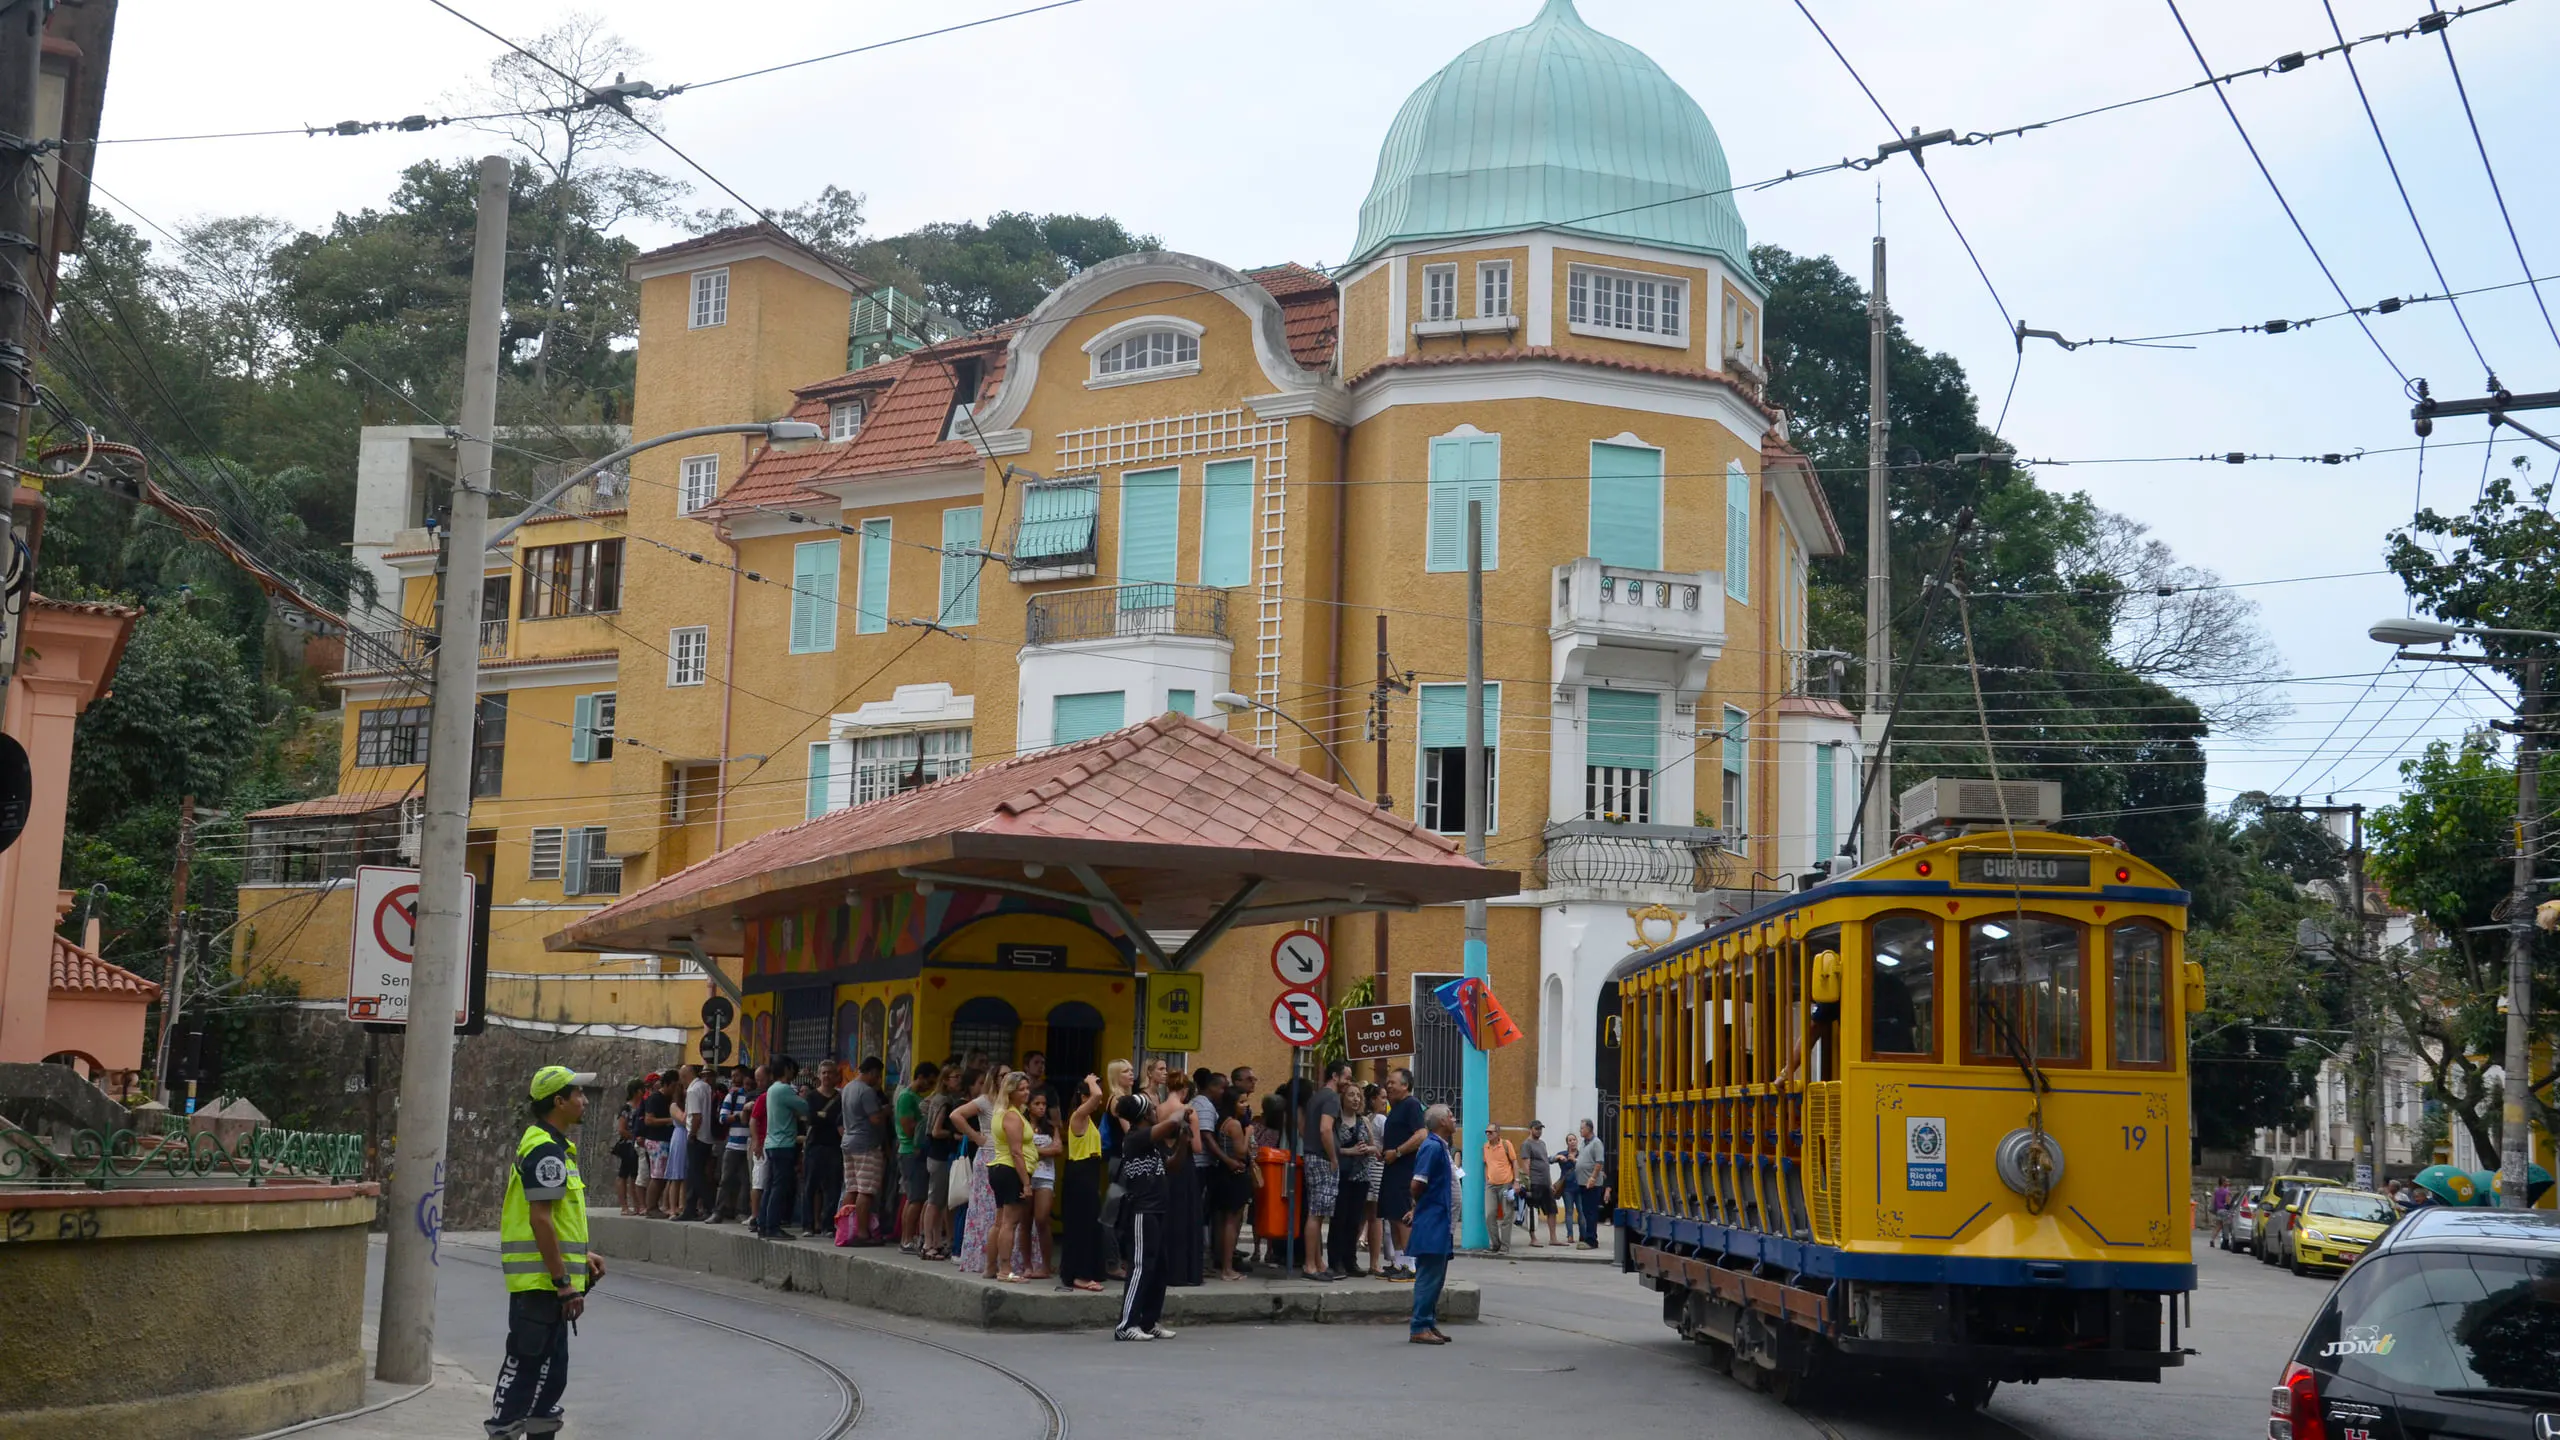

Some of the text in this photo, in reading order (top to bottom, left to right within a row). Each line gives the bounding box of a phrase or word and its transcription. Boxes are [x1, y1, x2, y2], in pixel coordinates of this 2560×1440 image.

[1983, 858, 2058, 878] CURVELO
[381, 974, 410, 987] Sen
[379, 993, 407, 1007] Proi
[1289, 1001, 1308, 1034] E
[1357, 1029, 1402, 1040] Largo do
[1361, 1042, 1400, 1053] Curvelo
[2122, 1126, 2147, 1151] 19
[1910, 1172, 1937, 1180] Rio de
[1910, 1179, 1944, 1187] Janeiro
[2320, 1340, 2380, 1357] JDM
